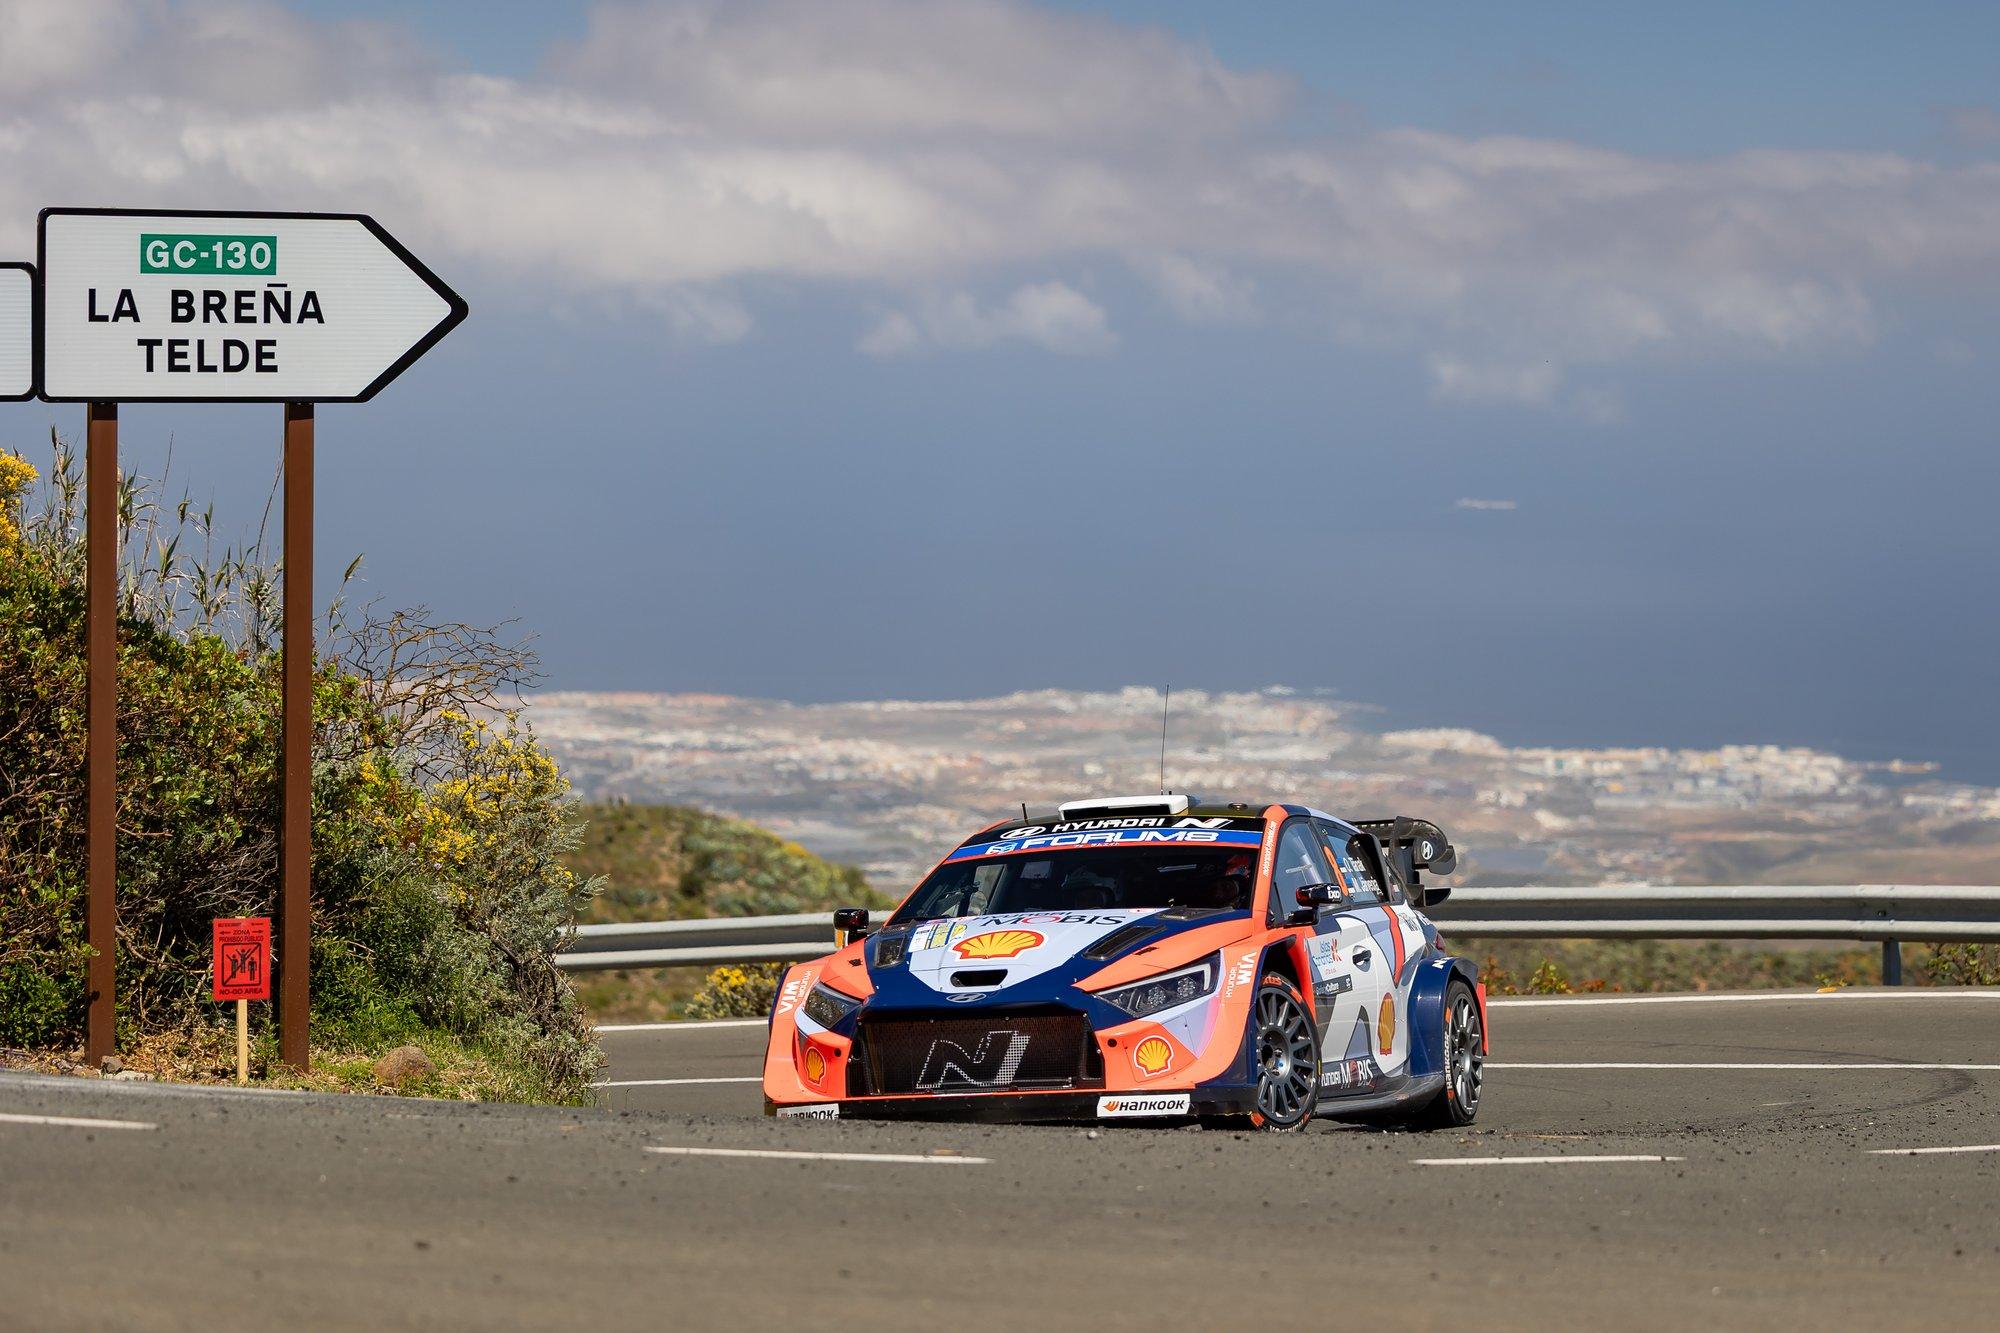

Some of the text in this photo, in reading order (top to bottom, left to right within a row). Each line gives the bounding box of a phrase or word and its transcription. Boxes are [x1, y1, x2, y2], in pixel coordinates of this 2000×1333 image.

[146, 240, 272, 270] GC-130
[88, 283, 325, 324] LA BREÑA
[138, 338, 279, 373] TELDE
[1051, 818, 1164, 833] HYUNDAI
[1021, 831, 1219, 849] FORUM8
[982, 915, 1125, 927] MOBIS
[219, 987, 263, 996] NO-GO AREA
